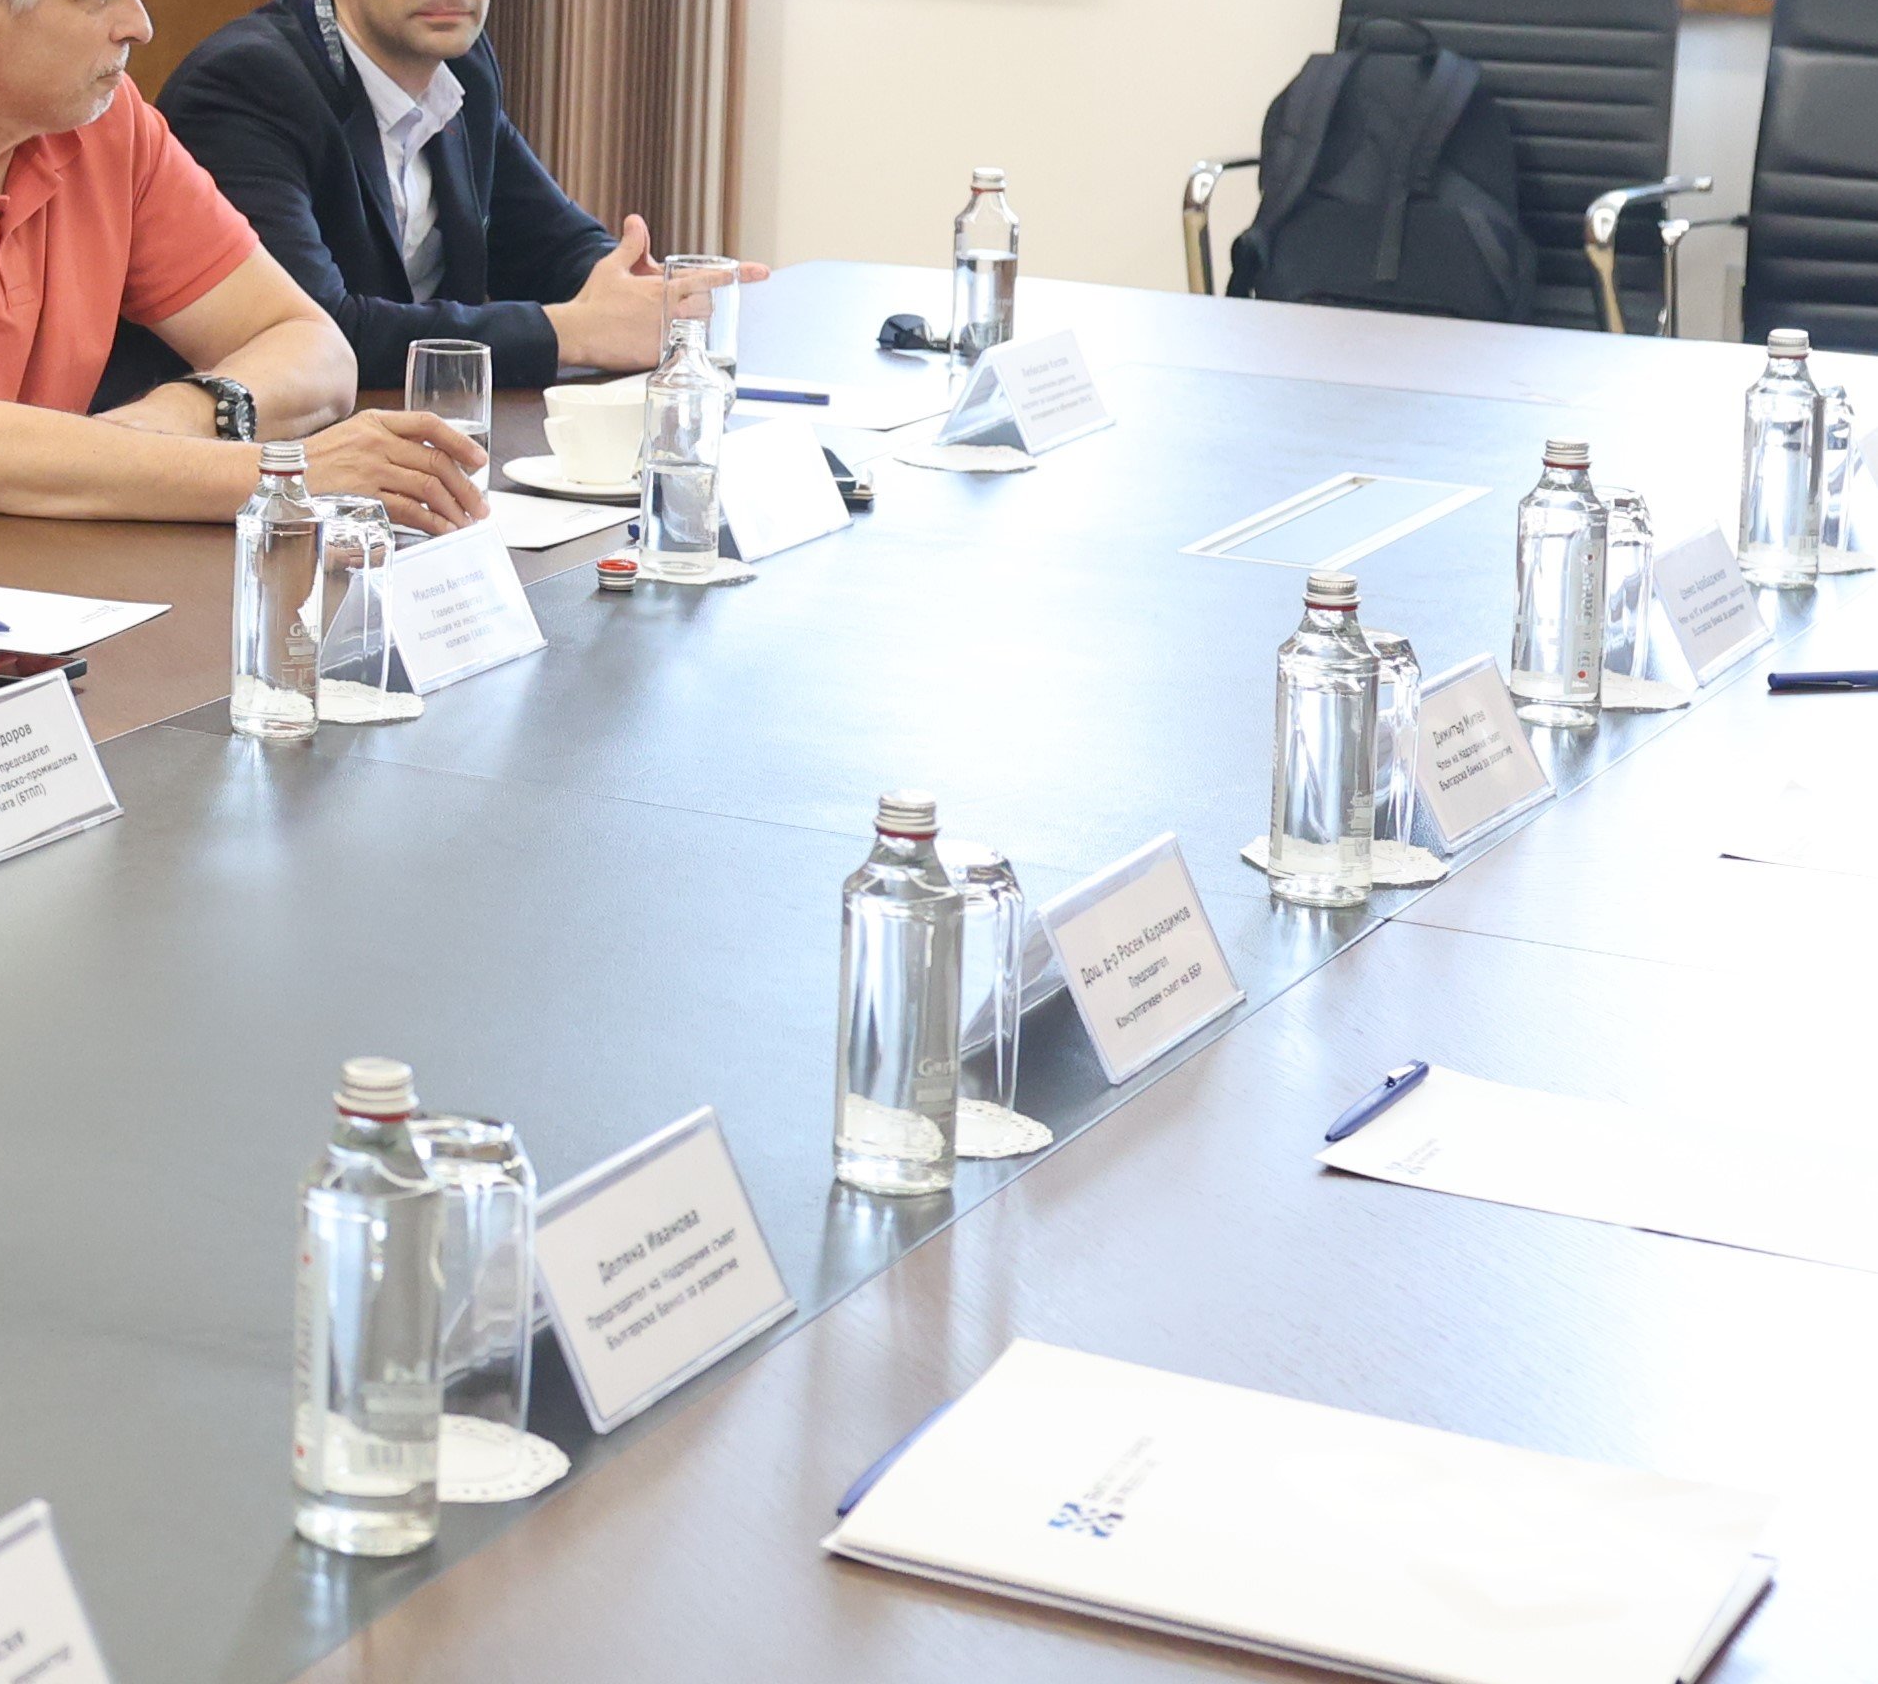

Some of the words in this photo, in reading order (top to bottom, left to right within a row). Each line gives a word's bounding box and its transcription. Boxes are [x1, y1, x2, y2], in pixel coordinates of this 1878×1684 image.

[412, 585, 445, 602] Милена
[447, 570, 484, 590] Ангелова
[17, 783, 47, 806] (БТПП)
[1103, 952, 1119, 975] д-р
[1117, 936, 1144, 962] Росен
[1142, 906, 1191, 944] Карадимов
